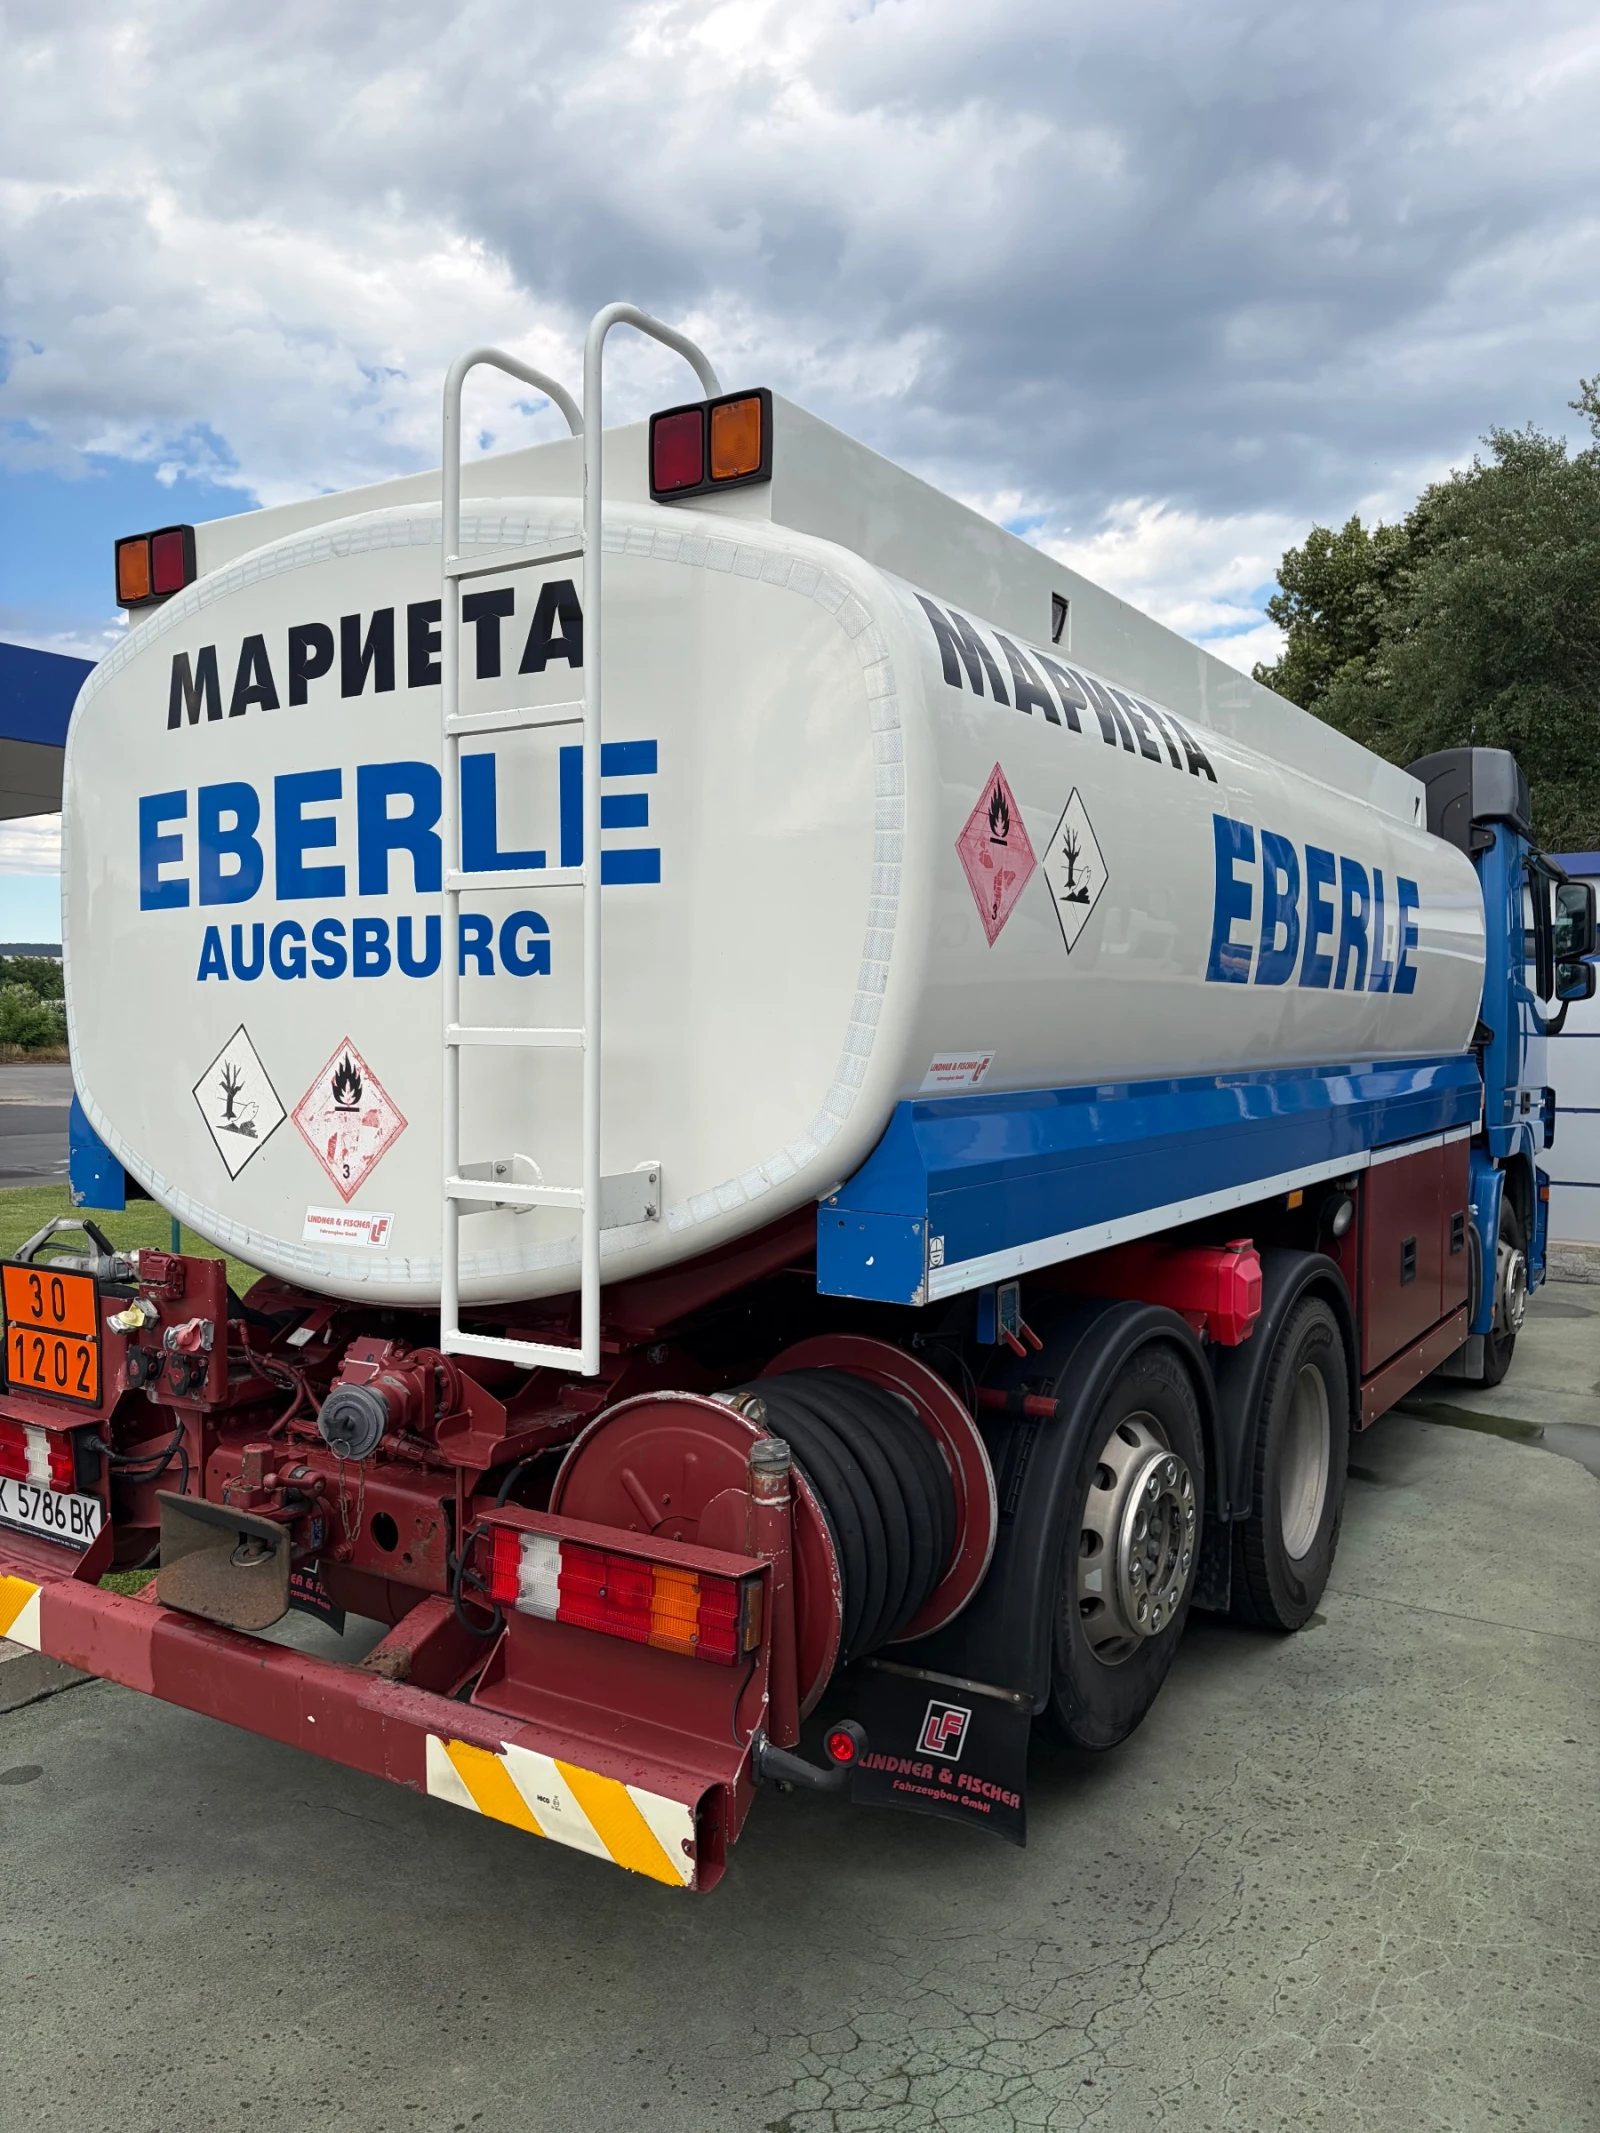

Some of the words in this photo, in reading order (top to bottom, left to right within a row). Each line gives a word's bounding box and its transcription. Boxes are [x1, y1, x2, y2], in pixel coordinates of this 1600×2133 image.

[912, 591, 1219, 785] МАРИЕТА
[138, 738, 661, 912] EBERLE
[991, 903, 998, 920] 3
[1205, 812, 1420, 995] EBERLE
[197, 910, 551, 982] AUGSBURG
[342, 1163, 350, 1179] 3
[307, 1215, 335, 1226] LINDNER
[336, 1218, 342, 1227] &
[343, 1219, 371, 1229] FISCHER
[29, 1273, 66, 1322] 30
[16, 1333, 90, 1393] 1202
[18, 1483, 66, 1530] 5786
[70, 1498, 96, 1540] BK
[893, 1780, 959, 1803] Fahrzeugbau
[961, 1796, 991, 1813] GmbH
[938, 1767, 953, 1784] &
[957, 1773, 1021, 1809] FISCHER
